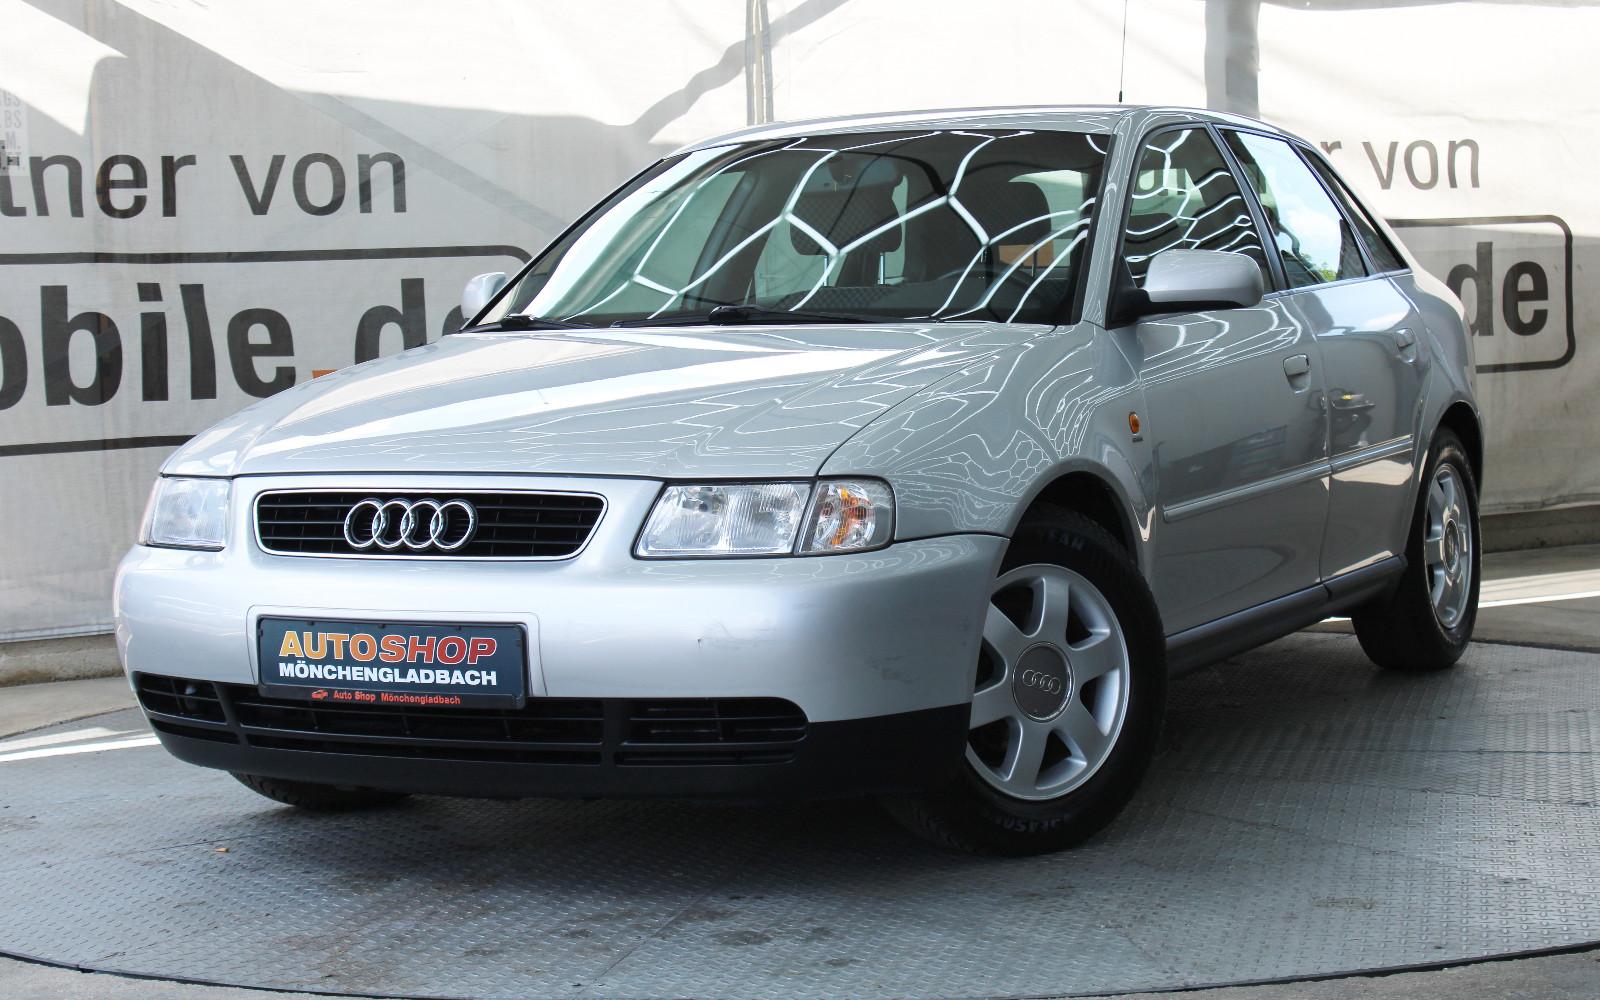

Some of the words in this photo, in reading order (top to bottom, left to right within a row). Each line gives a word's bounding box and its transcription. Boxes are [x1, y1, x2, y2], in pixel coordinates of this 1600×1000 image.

[1362, 139, 1480, 190] von
[230, 152, 407, 216] von
[279, 630, 497, 665] AUTOSHOP
[279, 660, 497, 686] MÖNCHENGLADBACH
[333, 690, 352, 700] Auto
[354, 691, 376, 702] Shop
[381, 692, 461, 705] Mönchengladbach
